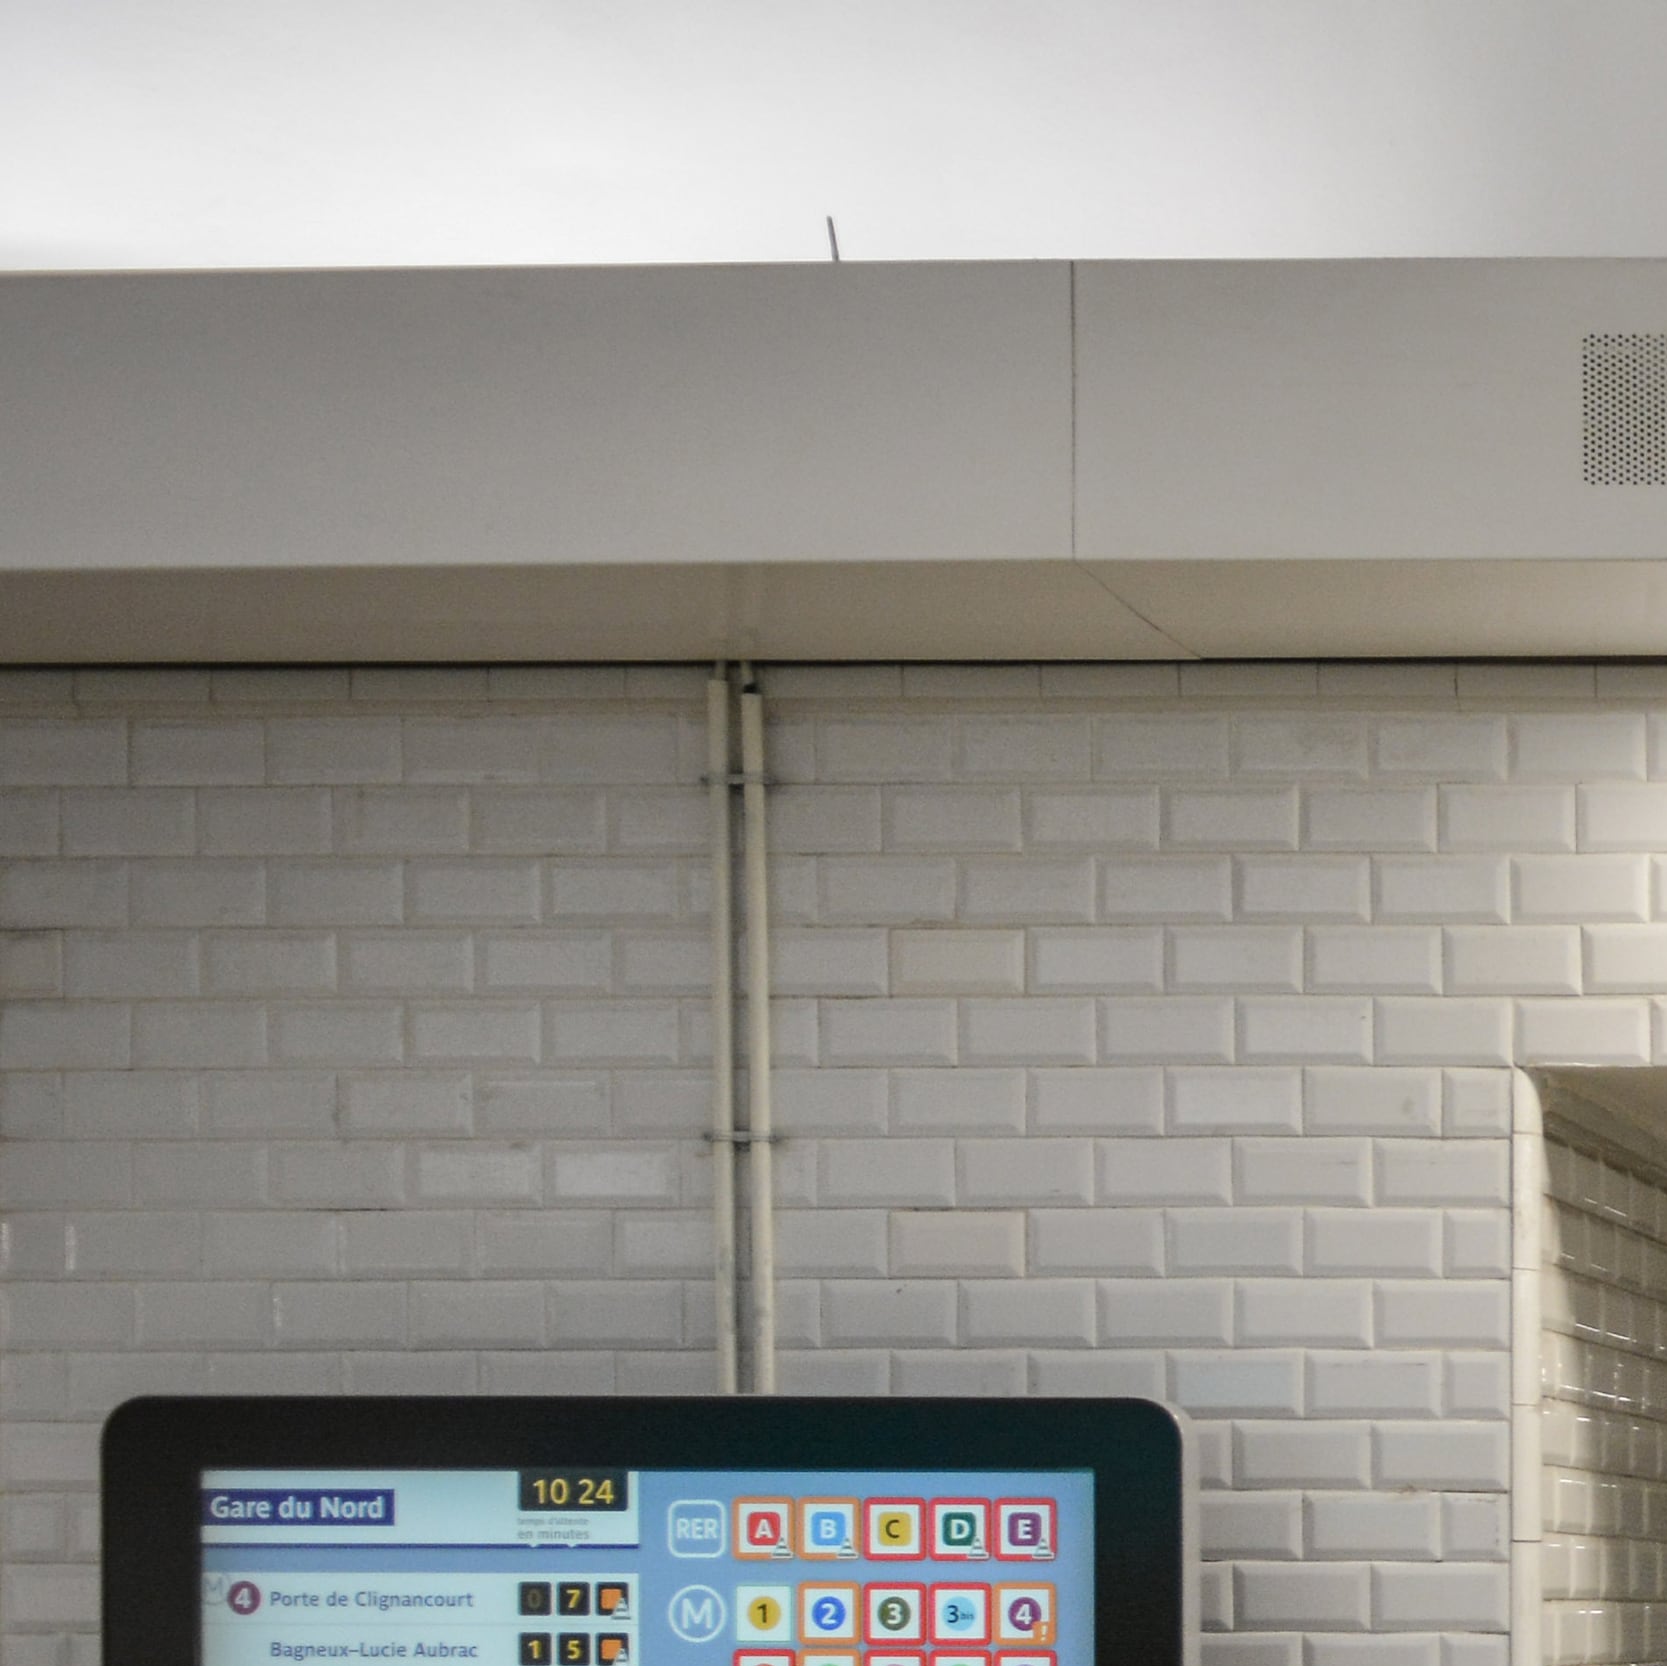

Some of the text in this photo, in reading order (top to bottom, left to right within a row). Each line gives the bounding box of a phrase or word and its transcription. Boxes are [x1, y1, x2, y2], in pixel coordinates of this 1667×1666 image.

[532, 1478, 615, 1505] 10 24
[210, 1496, 385, 1519] Gare du Nord
[537, 1529, 590, 1540] minutes
[676, 1518, 1032, 1539] RER A B C D E
[234, 1587, 474, 1611] 4 Porte de Clignancourt
[682, 1600, 713, 1627] M
[757, 1604, 769, 1626] 1
[820, 1603, 837, 1626] 2
[886, 1603, 903, 1626] 3
[1015, 1603, 1033, 1626] 4
[413, 1641, 479, 1658] Aubrac
